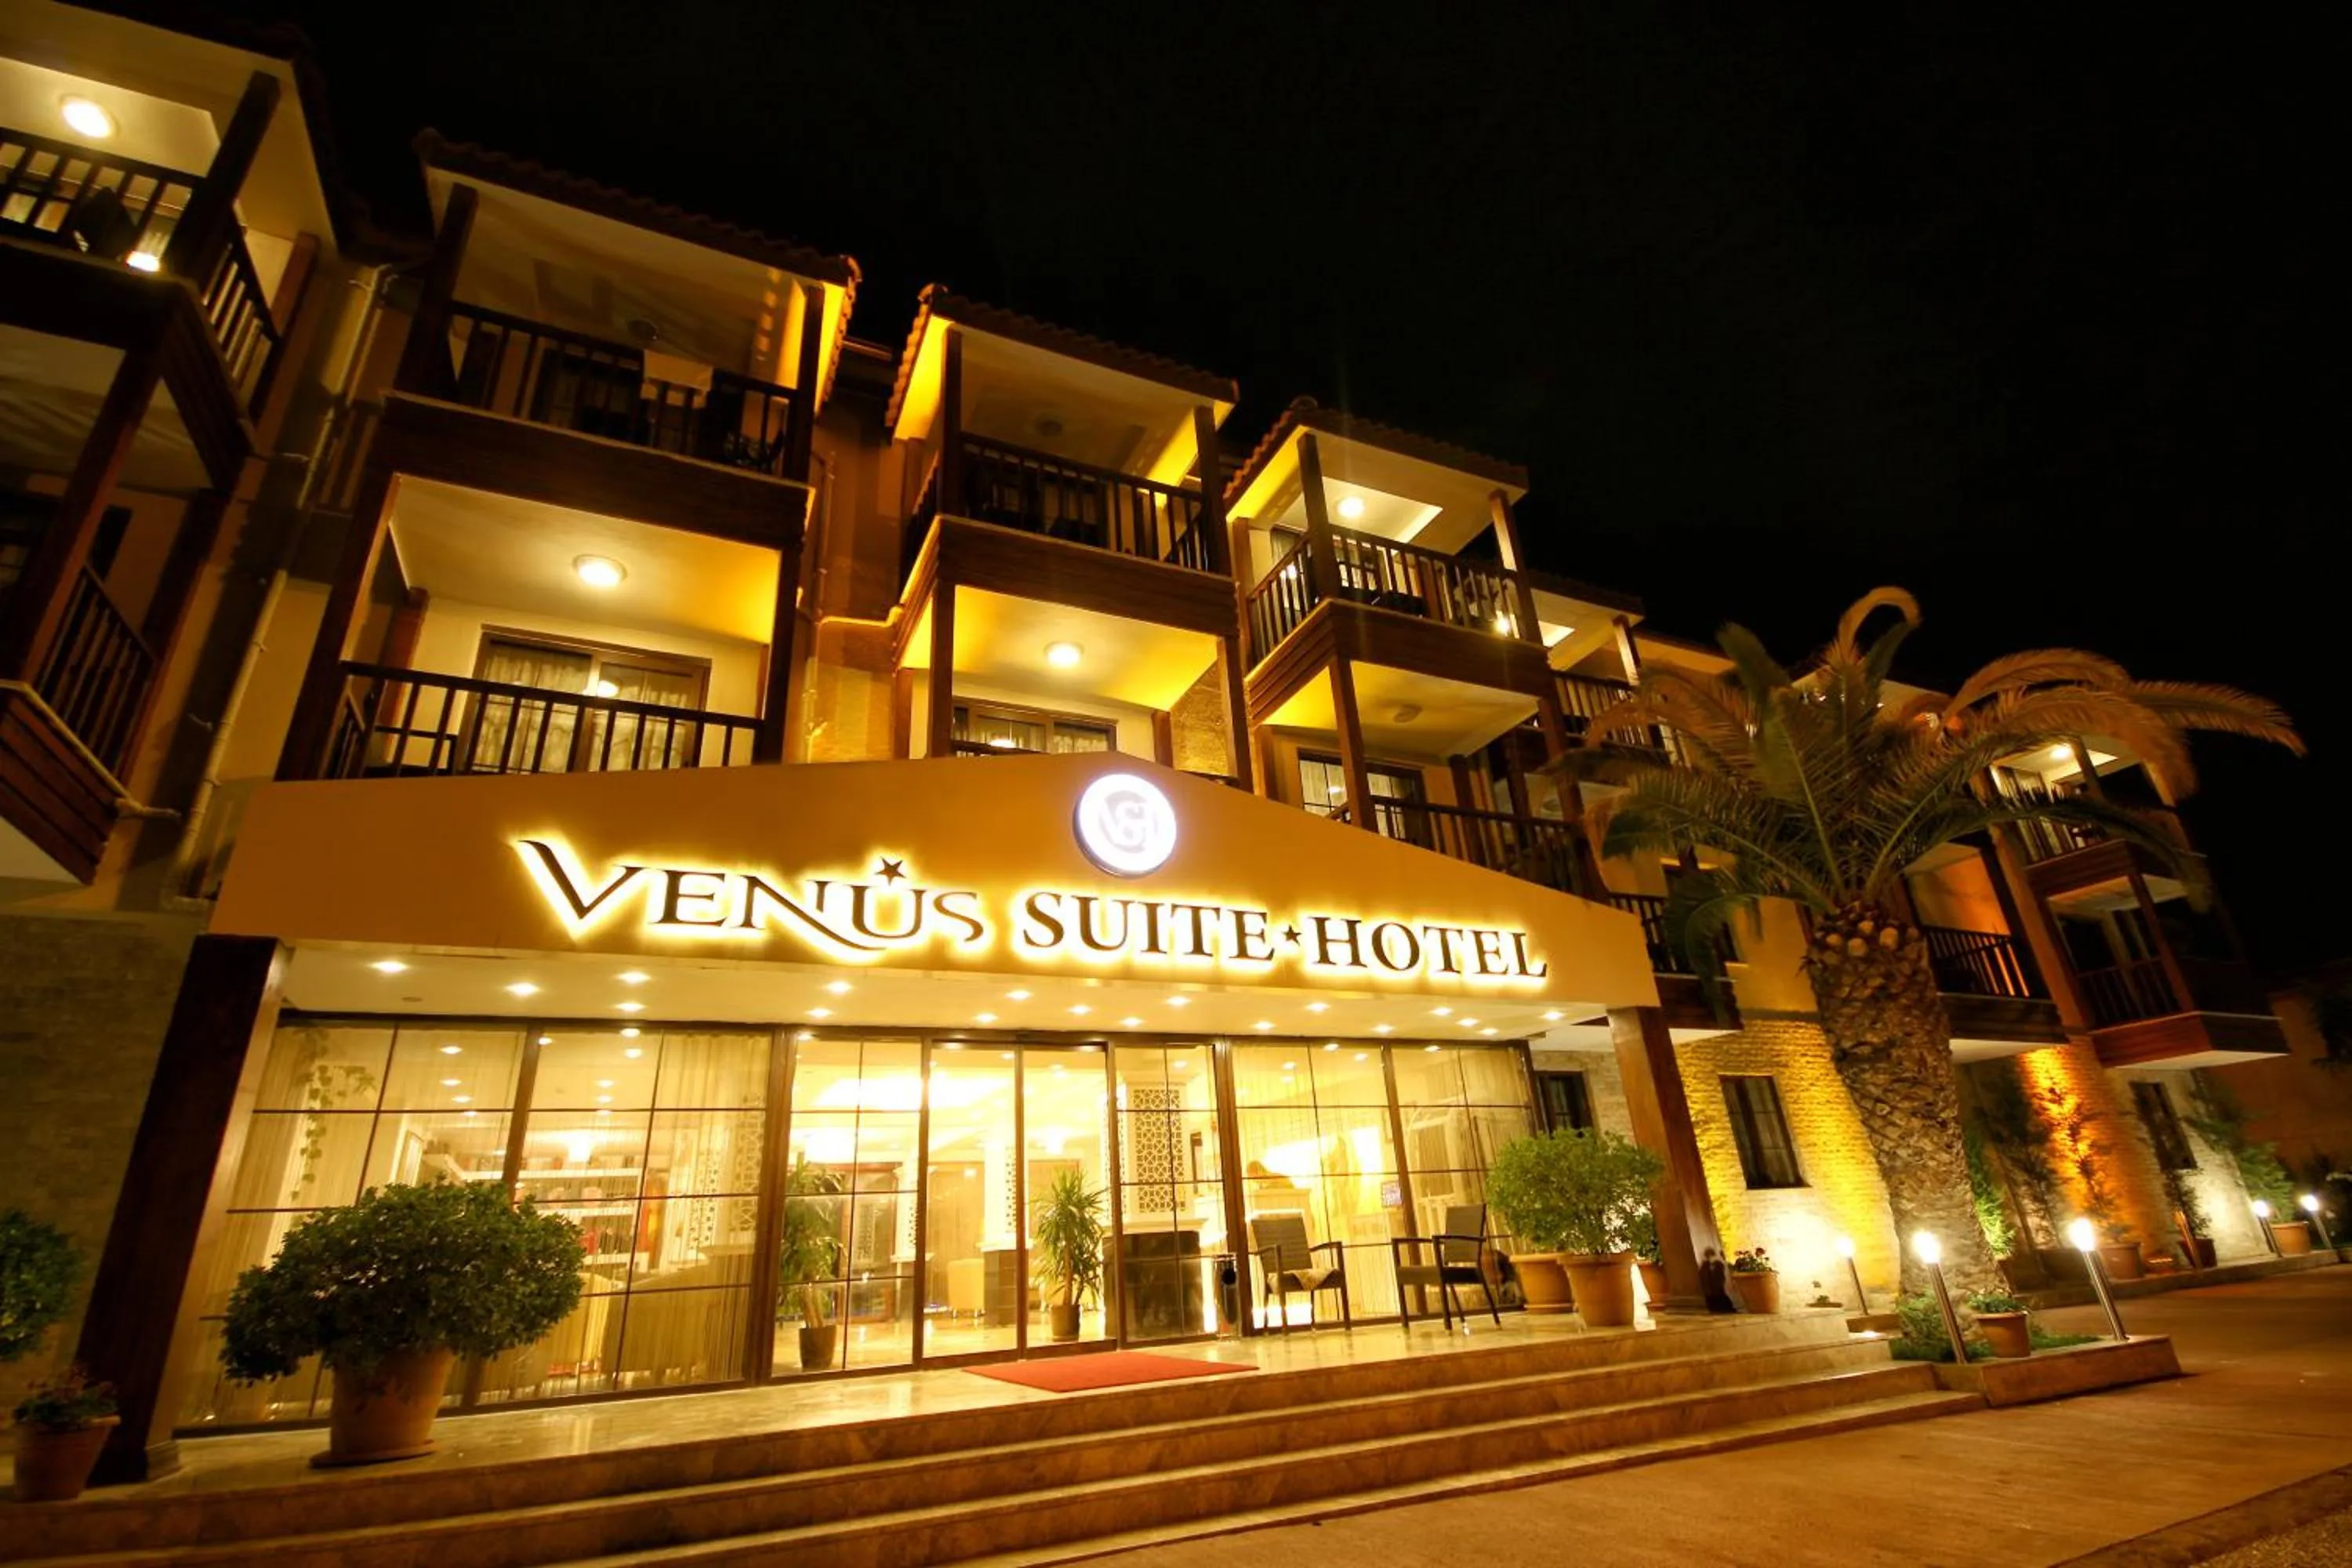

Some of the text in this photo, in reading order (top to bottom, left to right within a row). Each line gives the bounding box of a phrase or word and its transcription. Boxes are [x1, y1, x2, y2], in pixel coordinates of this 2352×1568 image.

[517, 839, 1548, 978] VENUS SUITE HOTEL
